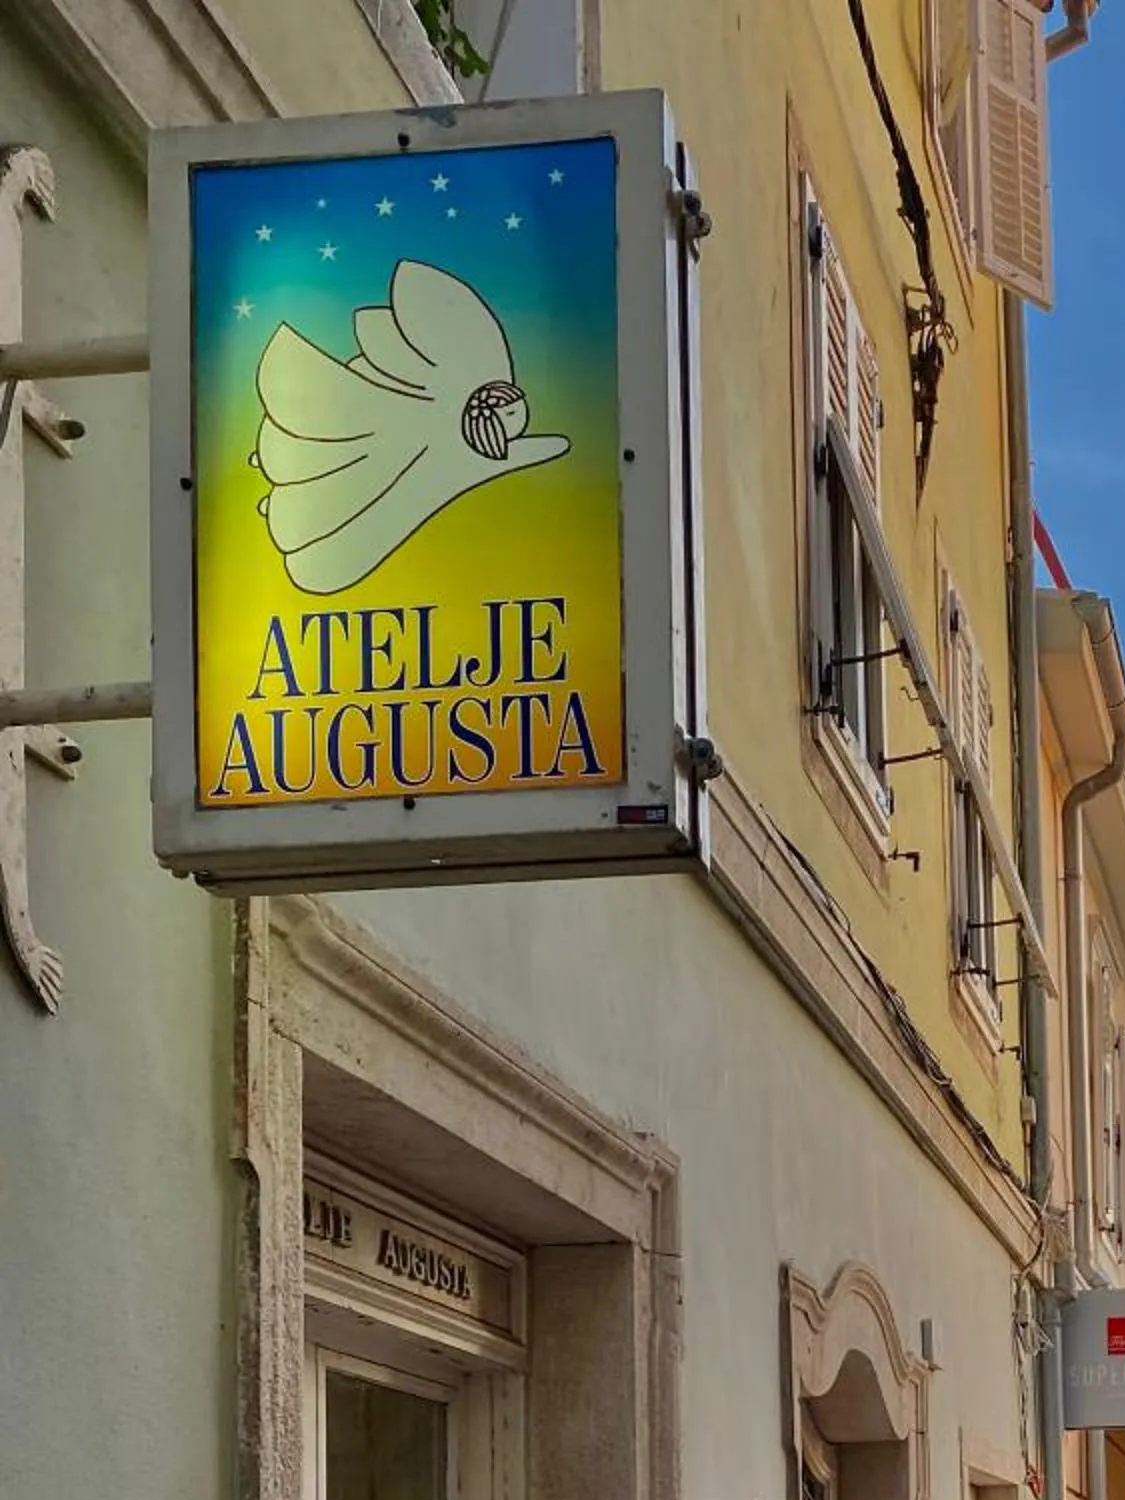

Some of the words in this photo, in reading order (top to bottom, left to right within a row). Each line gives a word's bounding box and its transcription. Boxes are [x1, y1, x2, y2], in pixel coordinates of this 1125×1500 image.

[247, 597, 567, 701] ATELJE
[209, 691, 608, 797] AUGUSTA
[304, 1193, 352, 1248] LJE
[378, 1229, 473, 1299] AUGUSTA
